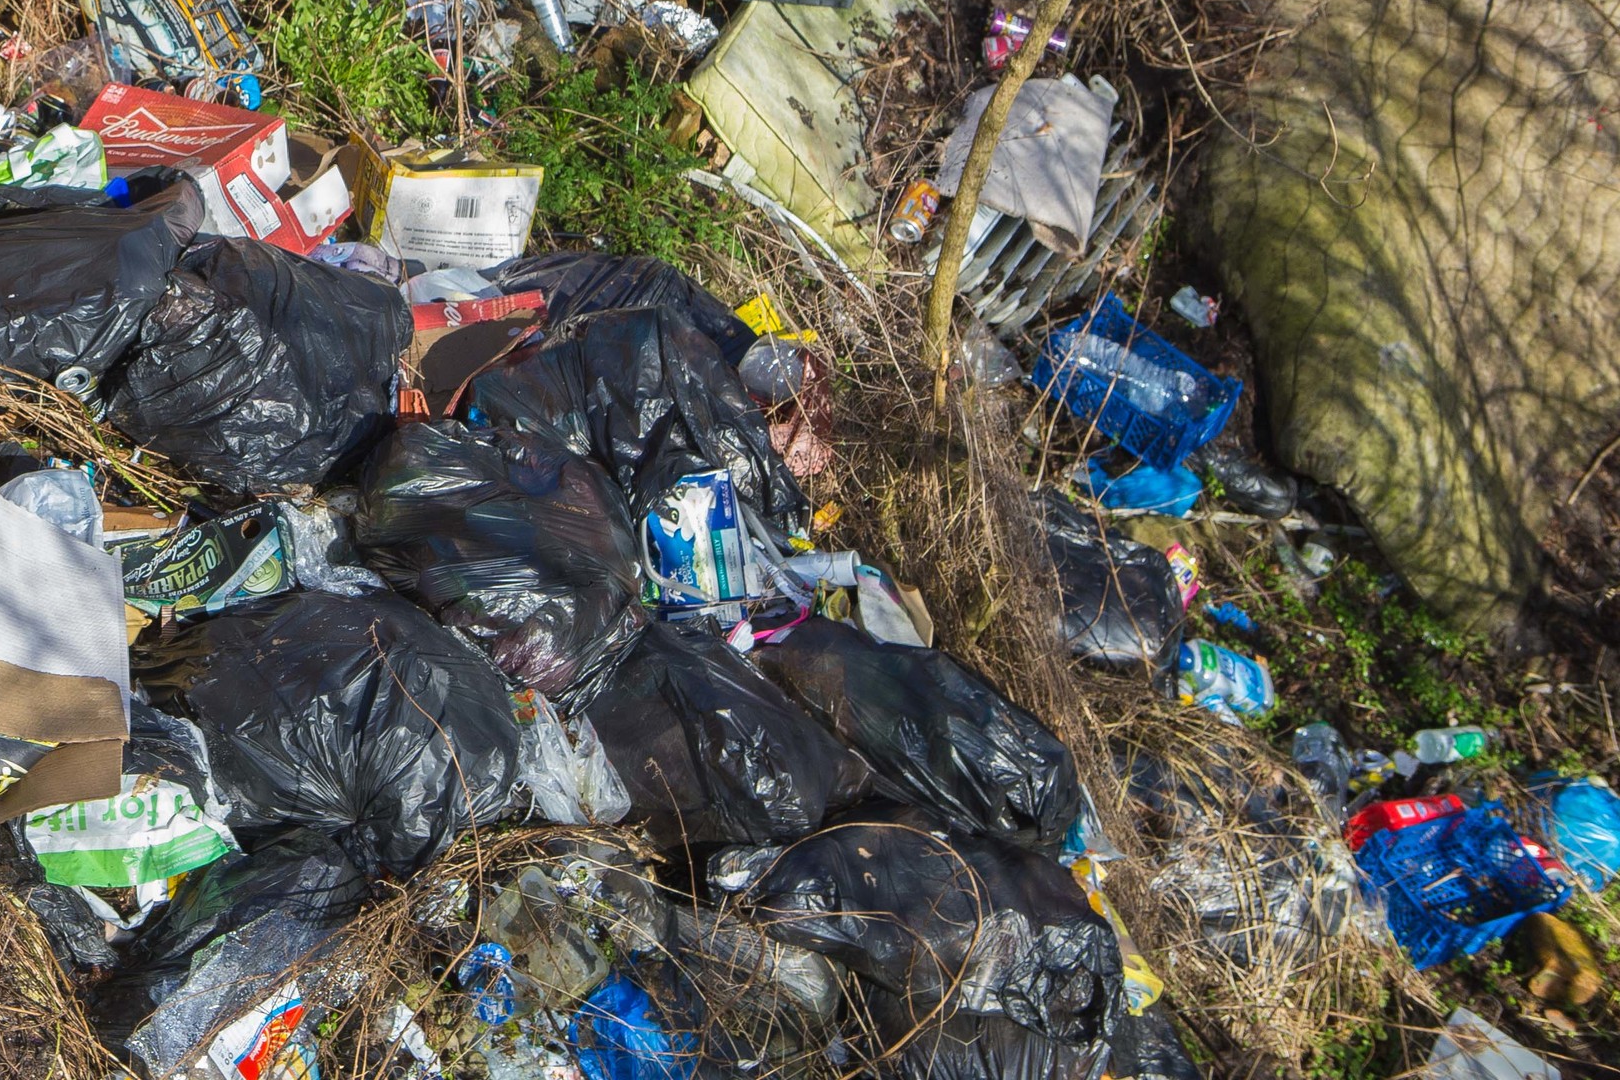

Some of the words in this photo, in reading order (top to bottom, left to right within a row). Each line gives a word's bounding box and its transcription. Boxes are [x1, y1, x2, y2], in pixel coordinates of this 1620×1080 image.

[100, 114, 232, 145] Budweiser
[249, 506, 263, 516] ALC.
[169, 576, 211, 599] PREMIUM
[102, 795, 158, 827] for
